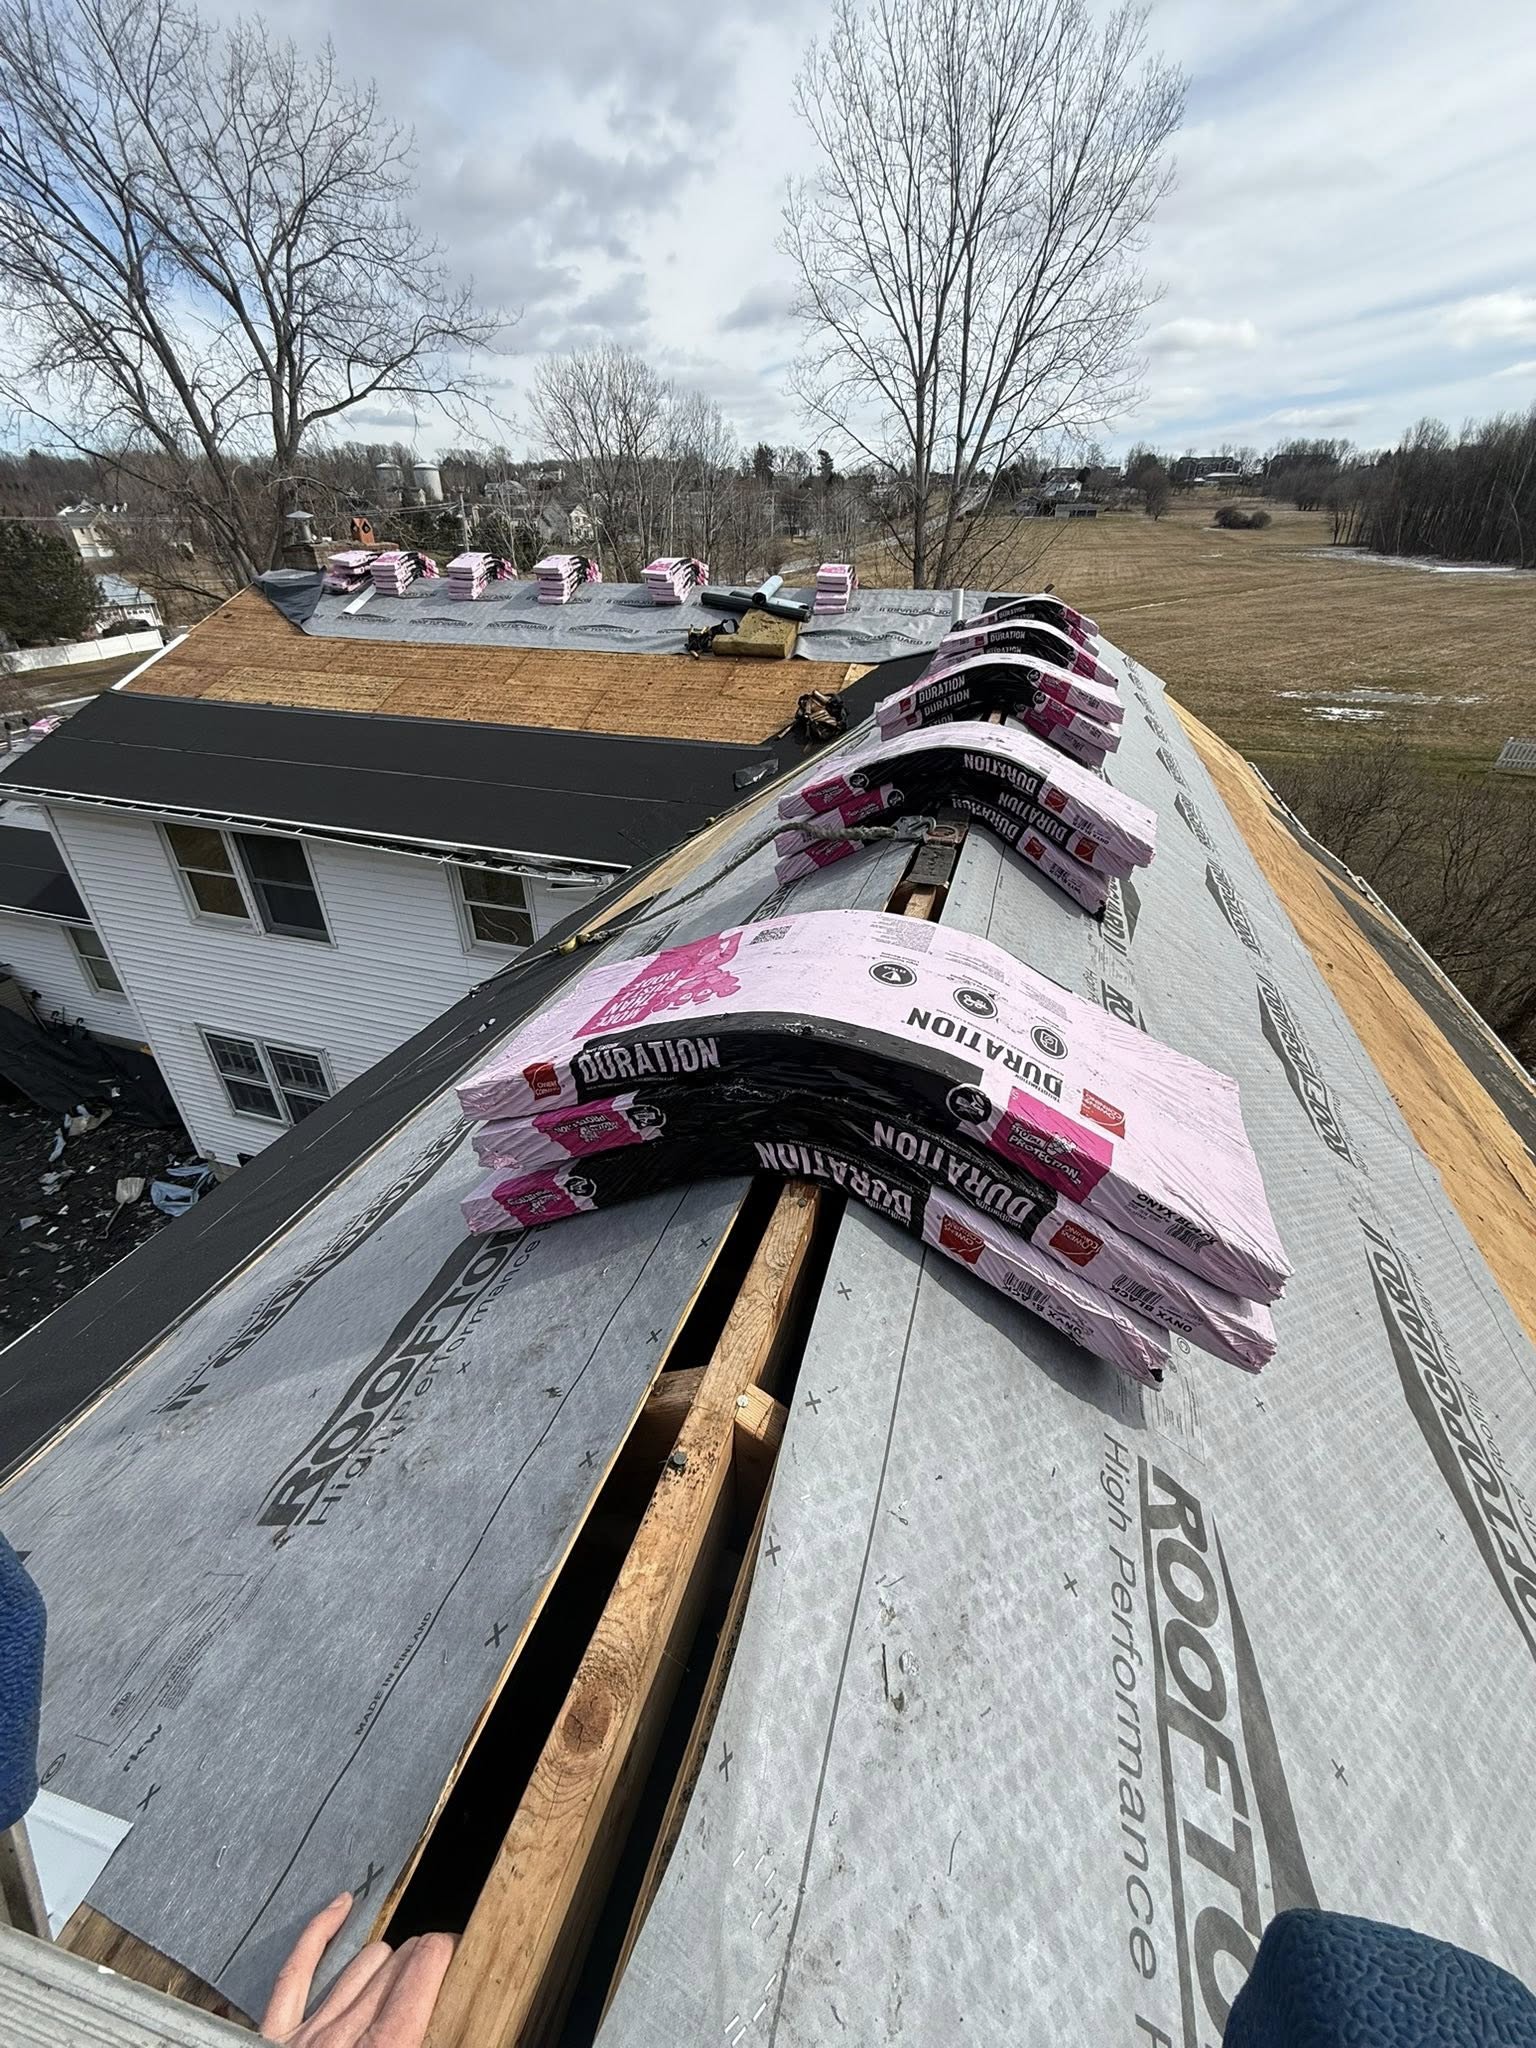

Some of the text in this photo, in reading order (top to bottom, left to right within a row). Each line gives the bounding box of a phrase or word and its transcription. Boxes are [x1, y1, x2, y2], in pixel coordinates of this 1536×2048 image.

[990, 630, 1026, 643] DURATION
[919, 674, 966, 704] DURATION
[923, 688, 970, 717] DURATION
[963, 752, 1039, 795] DURATION
[952, 798, 1020, 842] DURATION
[998, 792, 1069, 843] DURATION
[630, 968, 682, 990] ROOF
[591, 1006, 645, 1031] MORE
[604, 992, 657, 1017] THAN
[577, 1037, 721, 1084] DURATION
[905, 1006, 1063, 1099] DURATION
[753, 1141, 913, 1221] DURATION
[872, 1120, 1037, 1224] DURATION
[1008, 1135, 1078, 1180] PROTECTION
[1062, 1229, 1090, 1249] OWENS
[1136, 1192, 1175, 1220] ONYX
[1174, 1213, 1219, 1246] BLACK
[1357, 1215, 1392, 1253] II
[1001, 1283, 1084, 1337] BACK ONYX
[1109, 1283, 1194, 1334] BLACK ONYX
[1395, 1245, 1513, 1477] Underlayment Roofing
[1102, 1431, 1134, 1532] High
[354, 1611, 433, 1737] MADE IN FINLAND
[1107, 1544, 1157, 1981] Performance
[1150, 1463, 1263, 2048] ROOFTO
